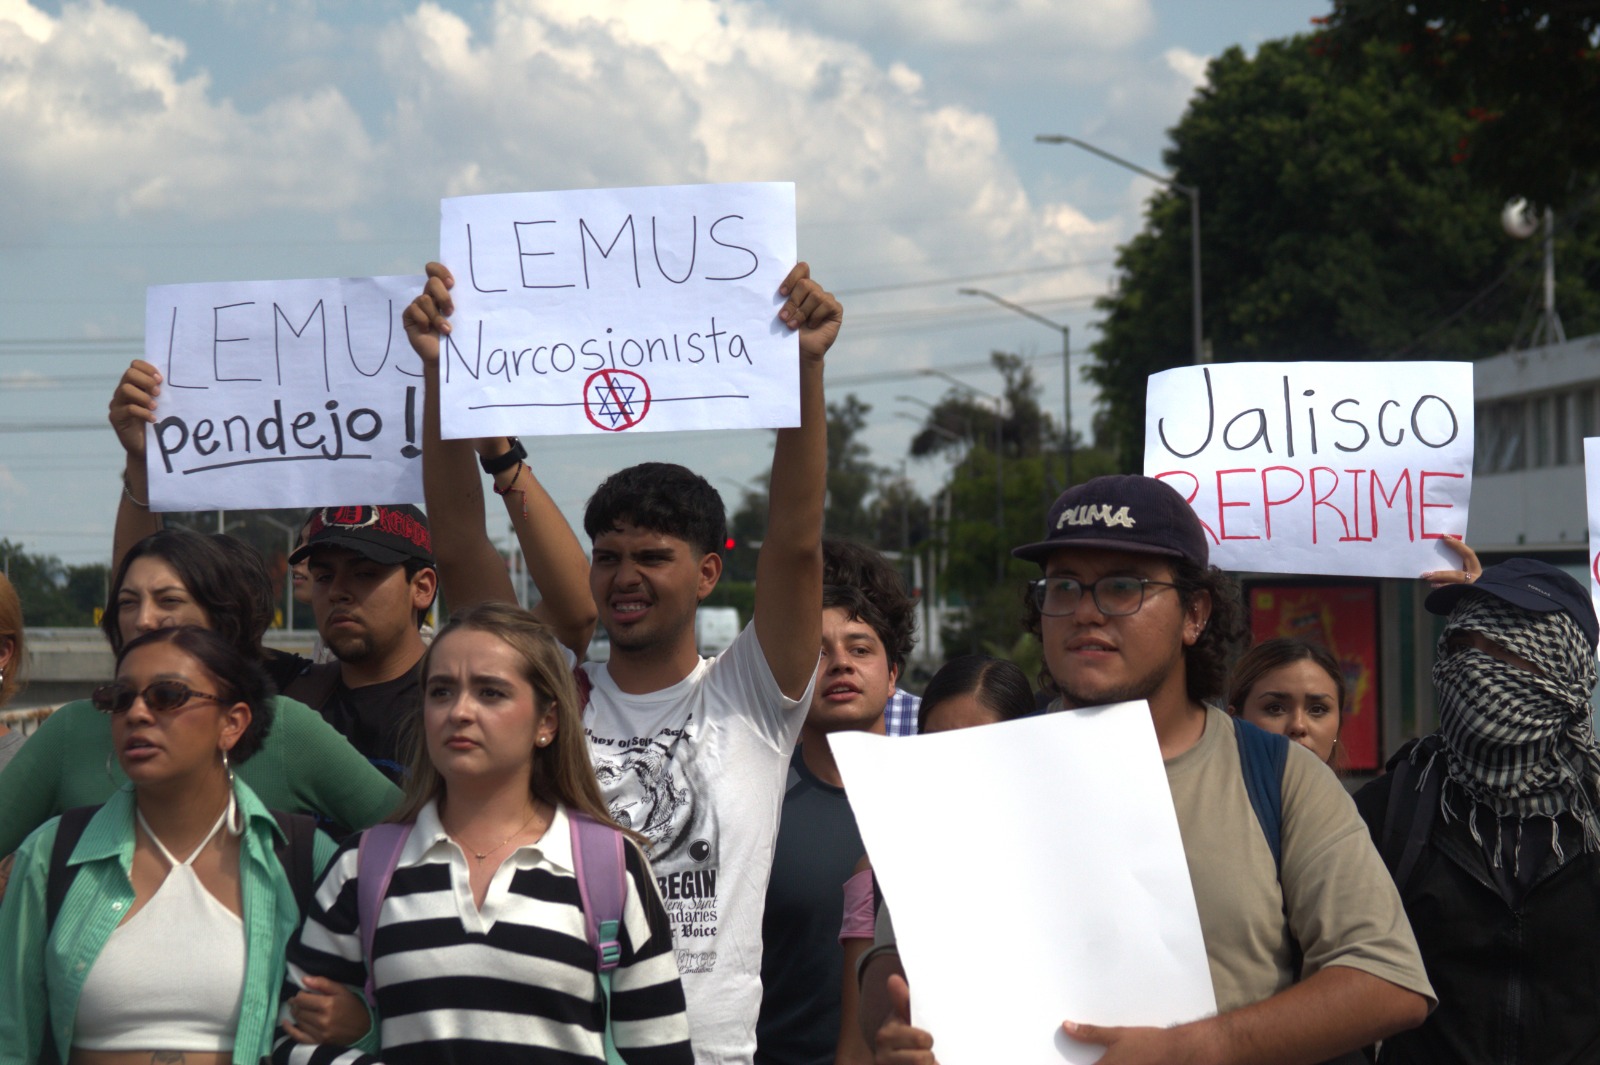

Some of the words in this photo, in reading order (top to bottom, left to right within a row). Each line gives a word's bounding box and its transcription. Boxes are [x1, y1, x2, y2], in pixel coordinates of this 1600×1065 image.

[466, 213, 759, 294] LEMUS
[445, 317, 753, 384] Narcosionista
[1158, 367, 1459, 459] Jalisco
[1056, 503, 1136, 529] PUMA
[657, 869, 717, 900] BEGIN
